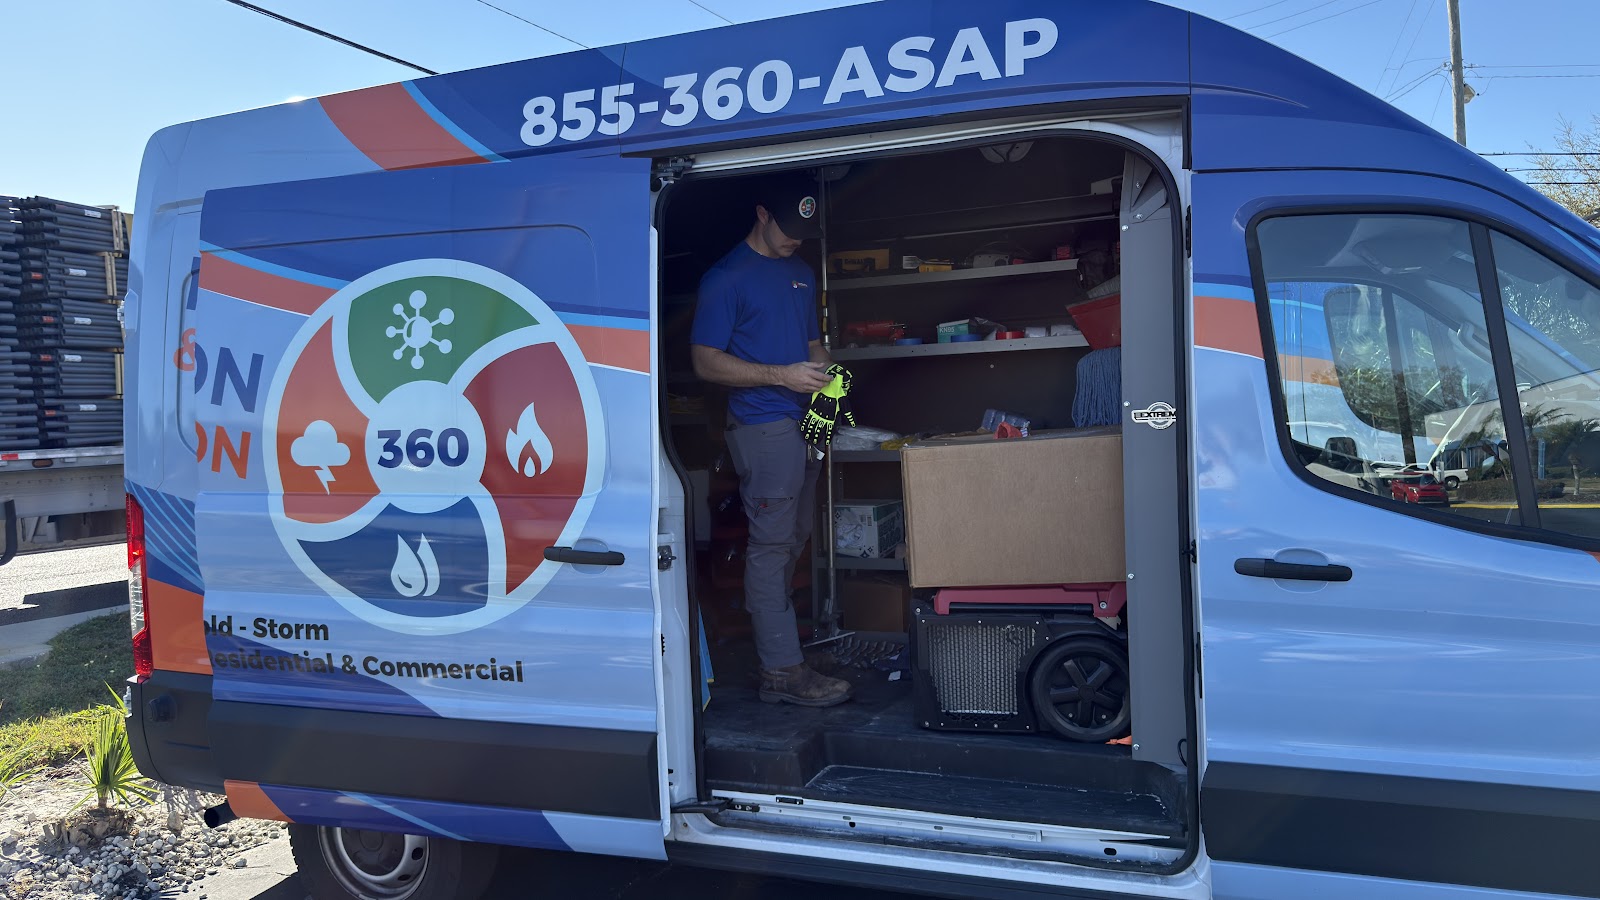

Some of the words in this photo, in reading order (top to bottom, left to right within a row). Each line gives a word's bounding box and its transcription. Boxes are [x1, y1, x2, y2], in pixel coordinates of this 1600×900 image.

[519, 18, 1059, 147] 855-360-ASAP
[194, 341, 264, 413] N
[377, 427, 469, 468] 360
[253, 617, 329, 640] Storm
[209, 647, 334, 673] esidential
[342, 653, 359, 675] &
[362, 655, 524, 682] Commercial
